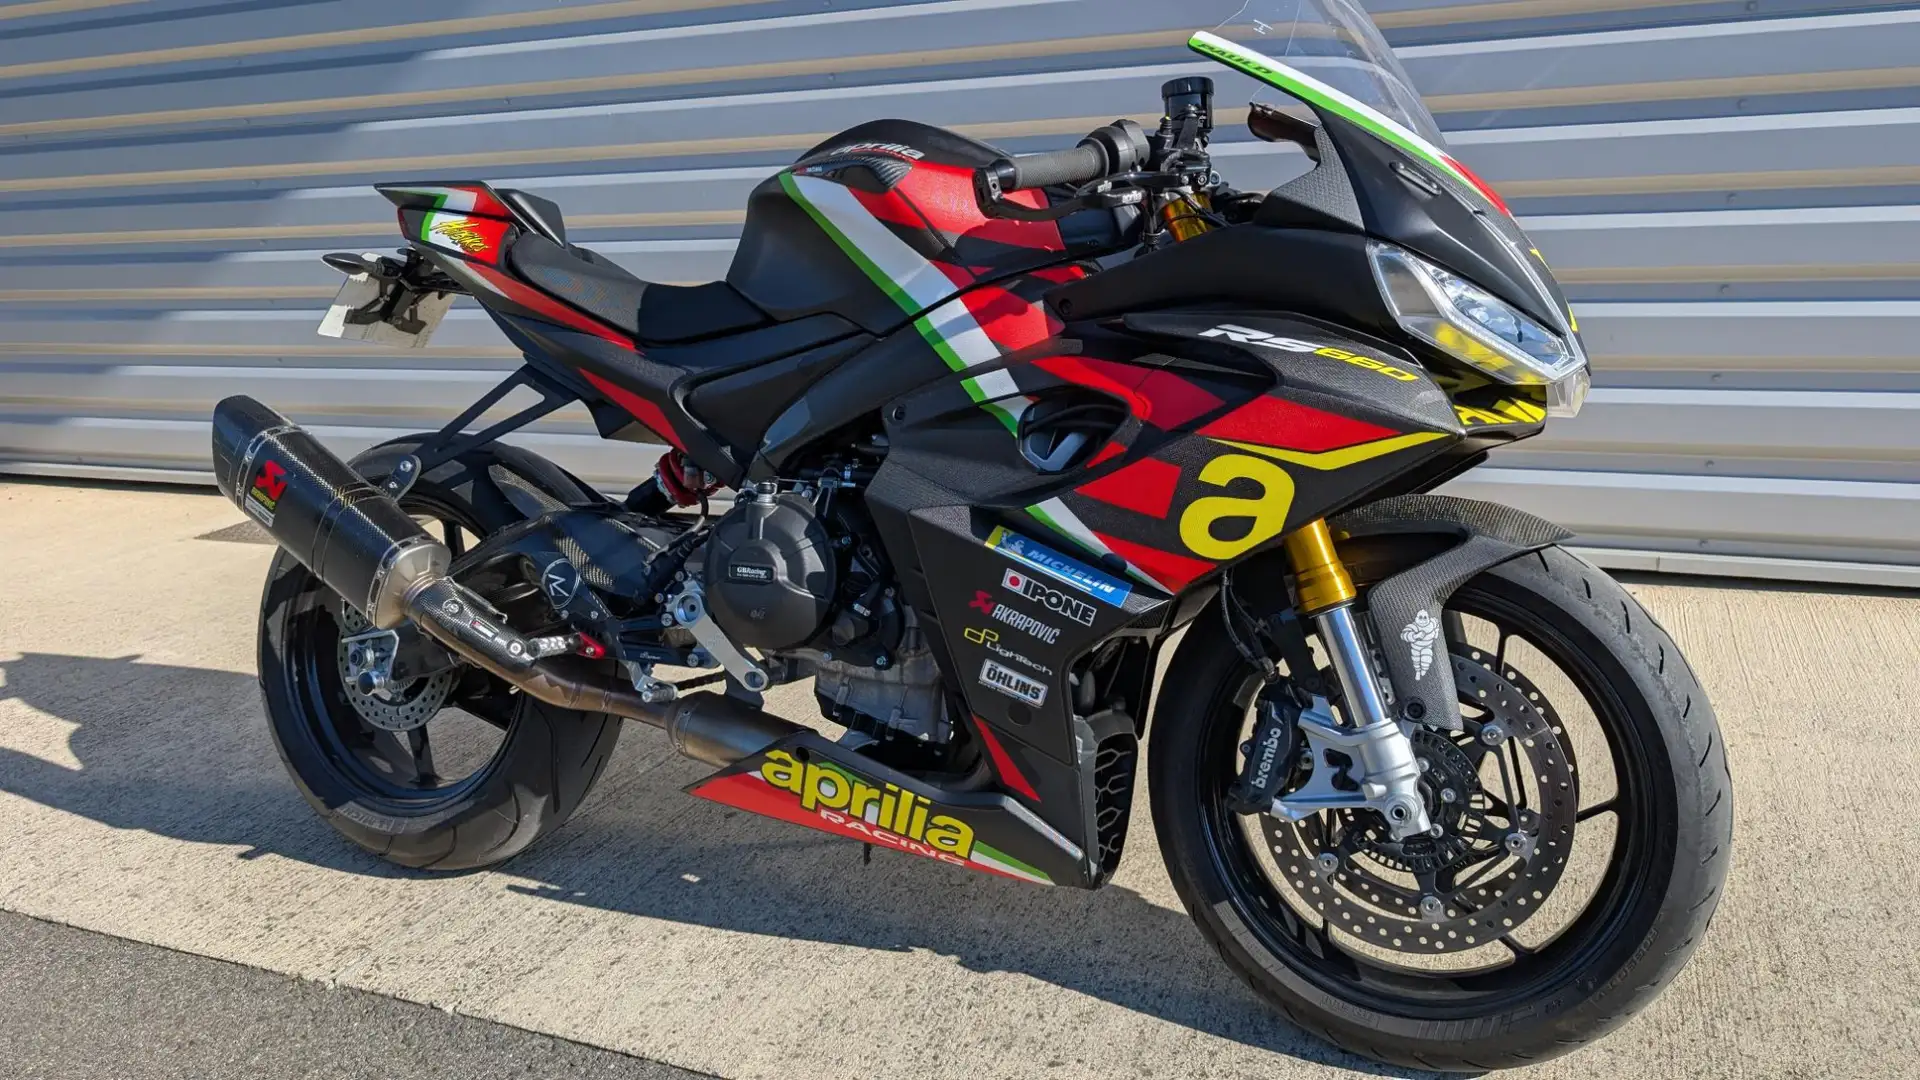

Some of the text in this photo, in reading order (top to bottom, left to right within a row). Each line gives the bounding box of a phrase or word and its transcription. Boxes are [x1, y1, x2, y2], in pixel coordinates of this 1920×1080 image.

[1179, 453, 1295, 560] a
[1028, 549, 1117, 594] MICHELIN
[1021, 579, 1097, 627] IPONE
[986, 663, 1043, 700] ÖHLINS
[1251, 727, 1282, 789] brembo
[761, 749, 975, 859] aprilia
[819, 809, 965, 867] RACING
